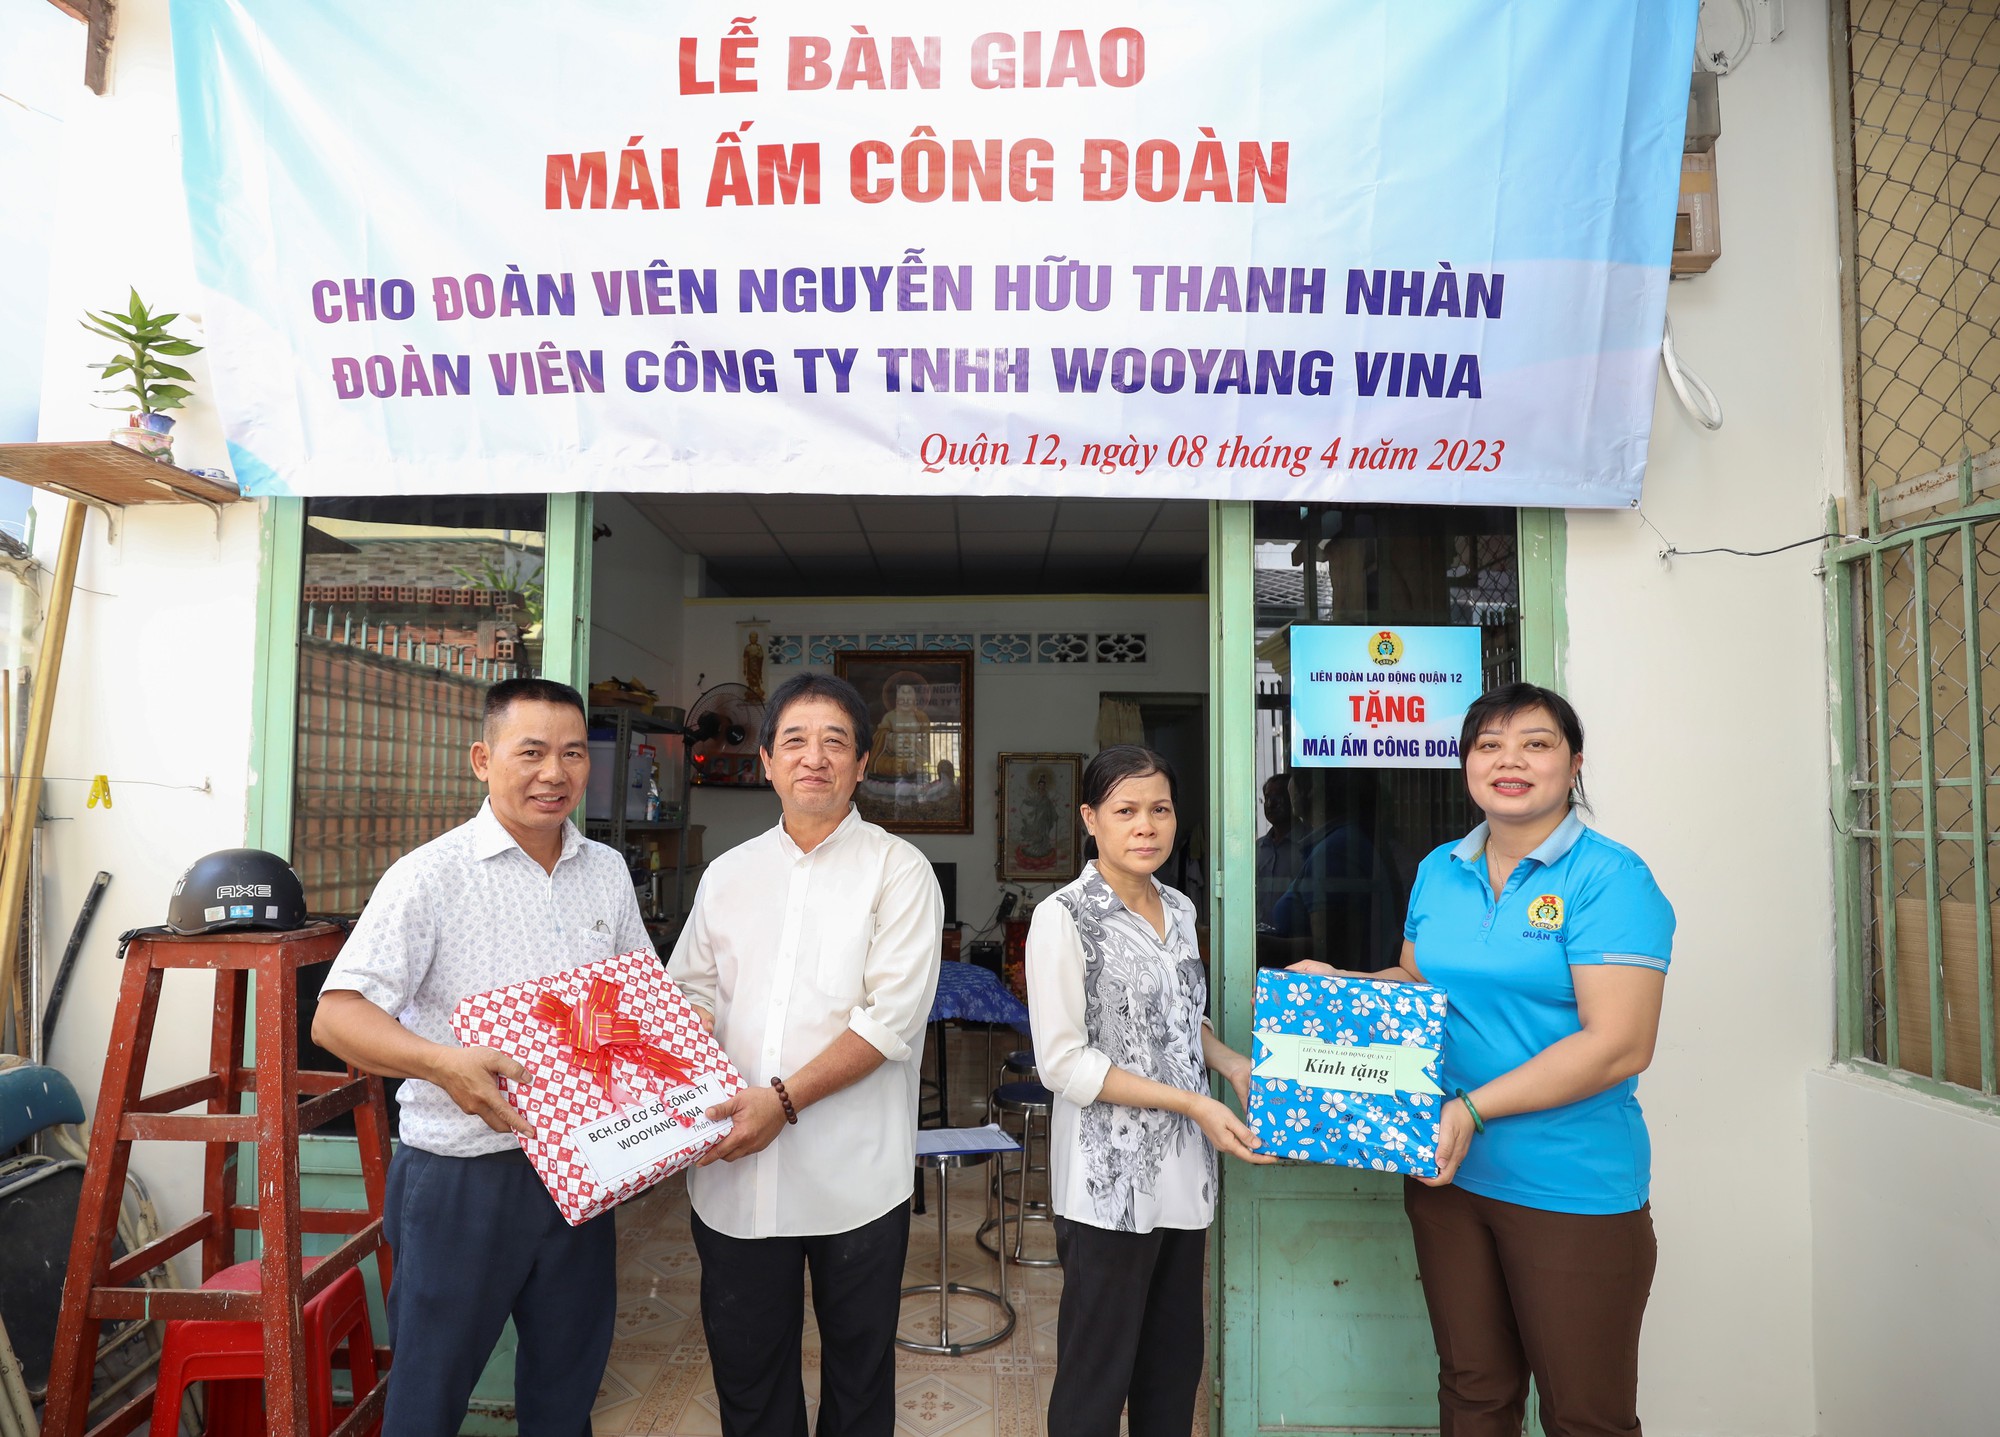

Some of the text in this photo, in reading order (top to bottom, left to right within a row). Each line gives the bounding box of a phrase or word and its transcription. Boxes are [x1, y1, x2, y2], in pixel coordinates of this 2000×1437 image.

[678, 15, 1146, 96] LỄ BÀN GIAO
[545, 120, 1290, 210] MÁI ẤM CÔNG ĐOÀN
[312, 248, 1505, 324] CHO ĐOÀN VIÊN NGUYỄN HỮU THANH NHÀN
[331, 340, 1483, 400] ĐOÀN VIÊN CÔNG TY TNHH WOOYANG VINA
[919, 432, 1506, 478] Quận 12, ngày 08 tháng 4 năm 2023
[1310, 670, 1463, 685] LIÊN ĐOÀN LAO ĐỘNG QUẬN 12
[1348, 690, 1425, 729] TẶNG
[1303, 733, 1460, 758] MÁI ẤM CÔNG ĐOÀ
[216, 884, 272, 899] AXE
[1522, 930, 1551, 942] QUẬN
[1304, 1057, 1390, 1084] Kính tặng
[588, 1118, 631, 1143] BCH.CĐ
[632, 1108, 649, 1124] CƠ
[694, 1083, 709, 1095] TY
[617, 1106, 704, 1150] WOOYANG INA
